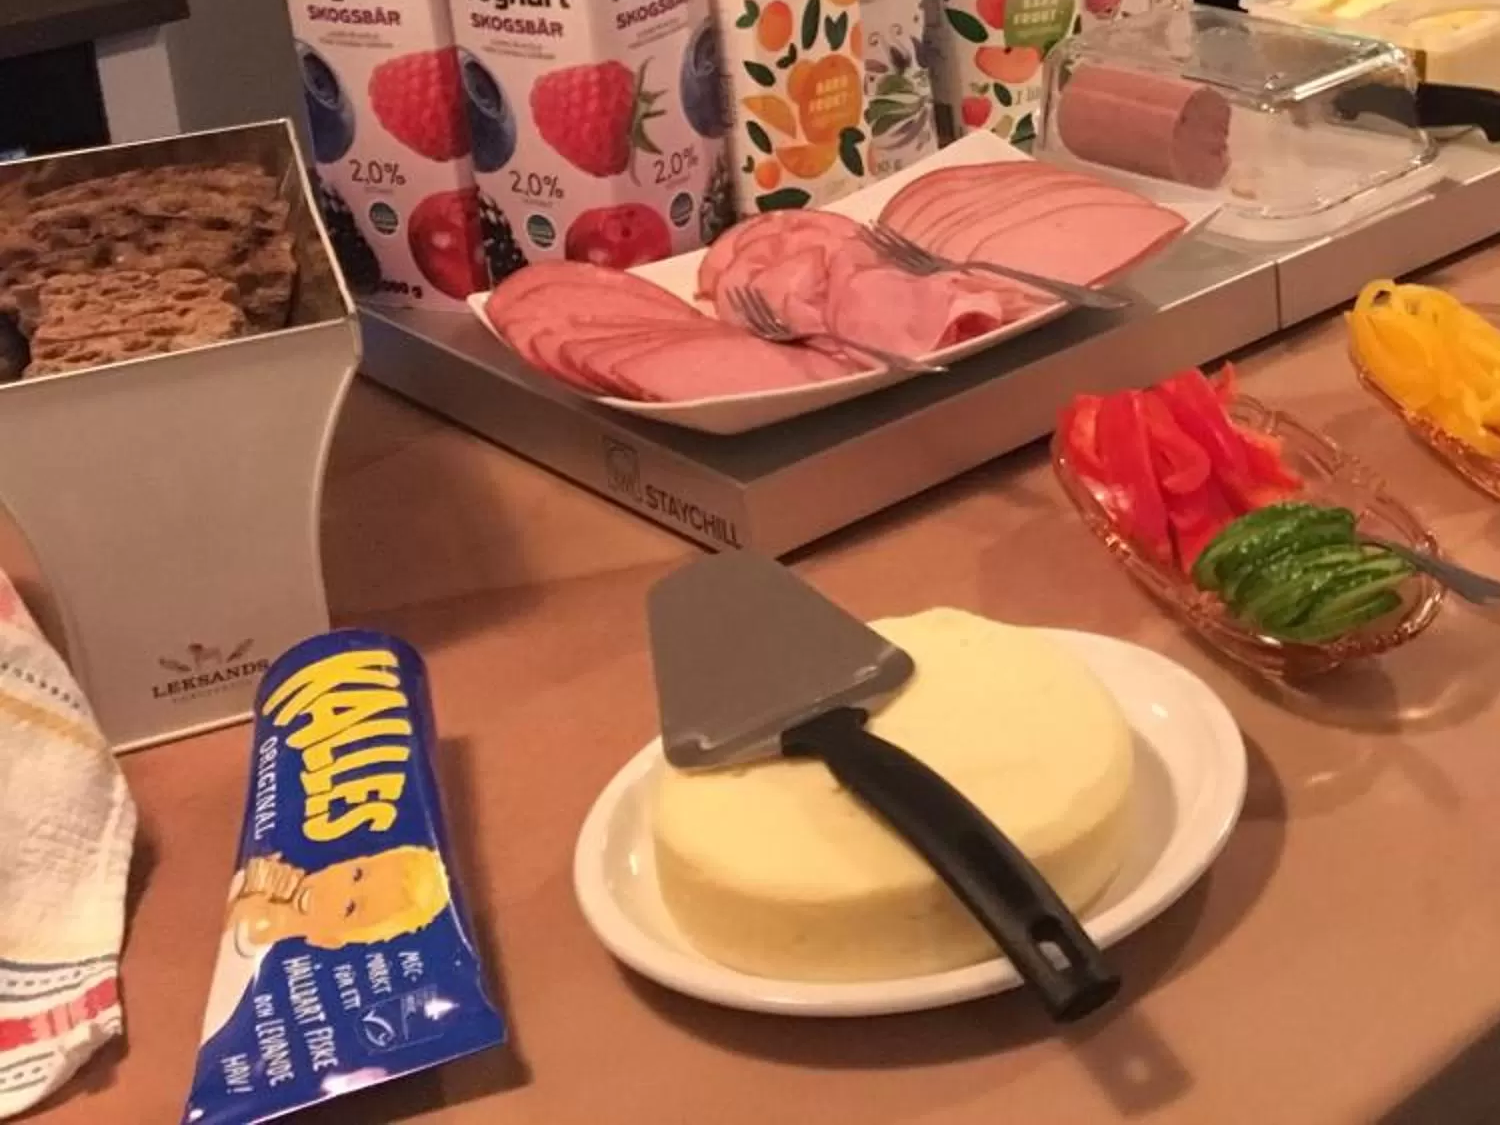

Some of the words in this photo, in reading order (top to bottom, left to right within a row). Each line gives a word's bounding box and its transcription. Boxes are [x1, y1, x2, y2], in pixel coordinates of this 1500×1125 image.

[307, 4, 401, 27] SKOGSBÄR
[470, 12, 564, 37] SKOGSBÄR
[151, 658, 269, 700] LEKSANDS
[263, 649, 413, 843] KALLES
[255, 735, 279, 840] ORIGINAL
[253, 992, 274, 1019] OCH
[282, 954, 327, 1025] HÅLLBART
[338, 986, 361, 1011] ETT
[255, 1017, 295, 1088] LEVANDE
[303, 1025, 339, 1072] FISKE
[220, 1053, 254, 1094] HAV!
